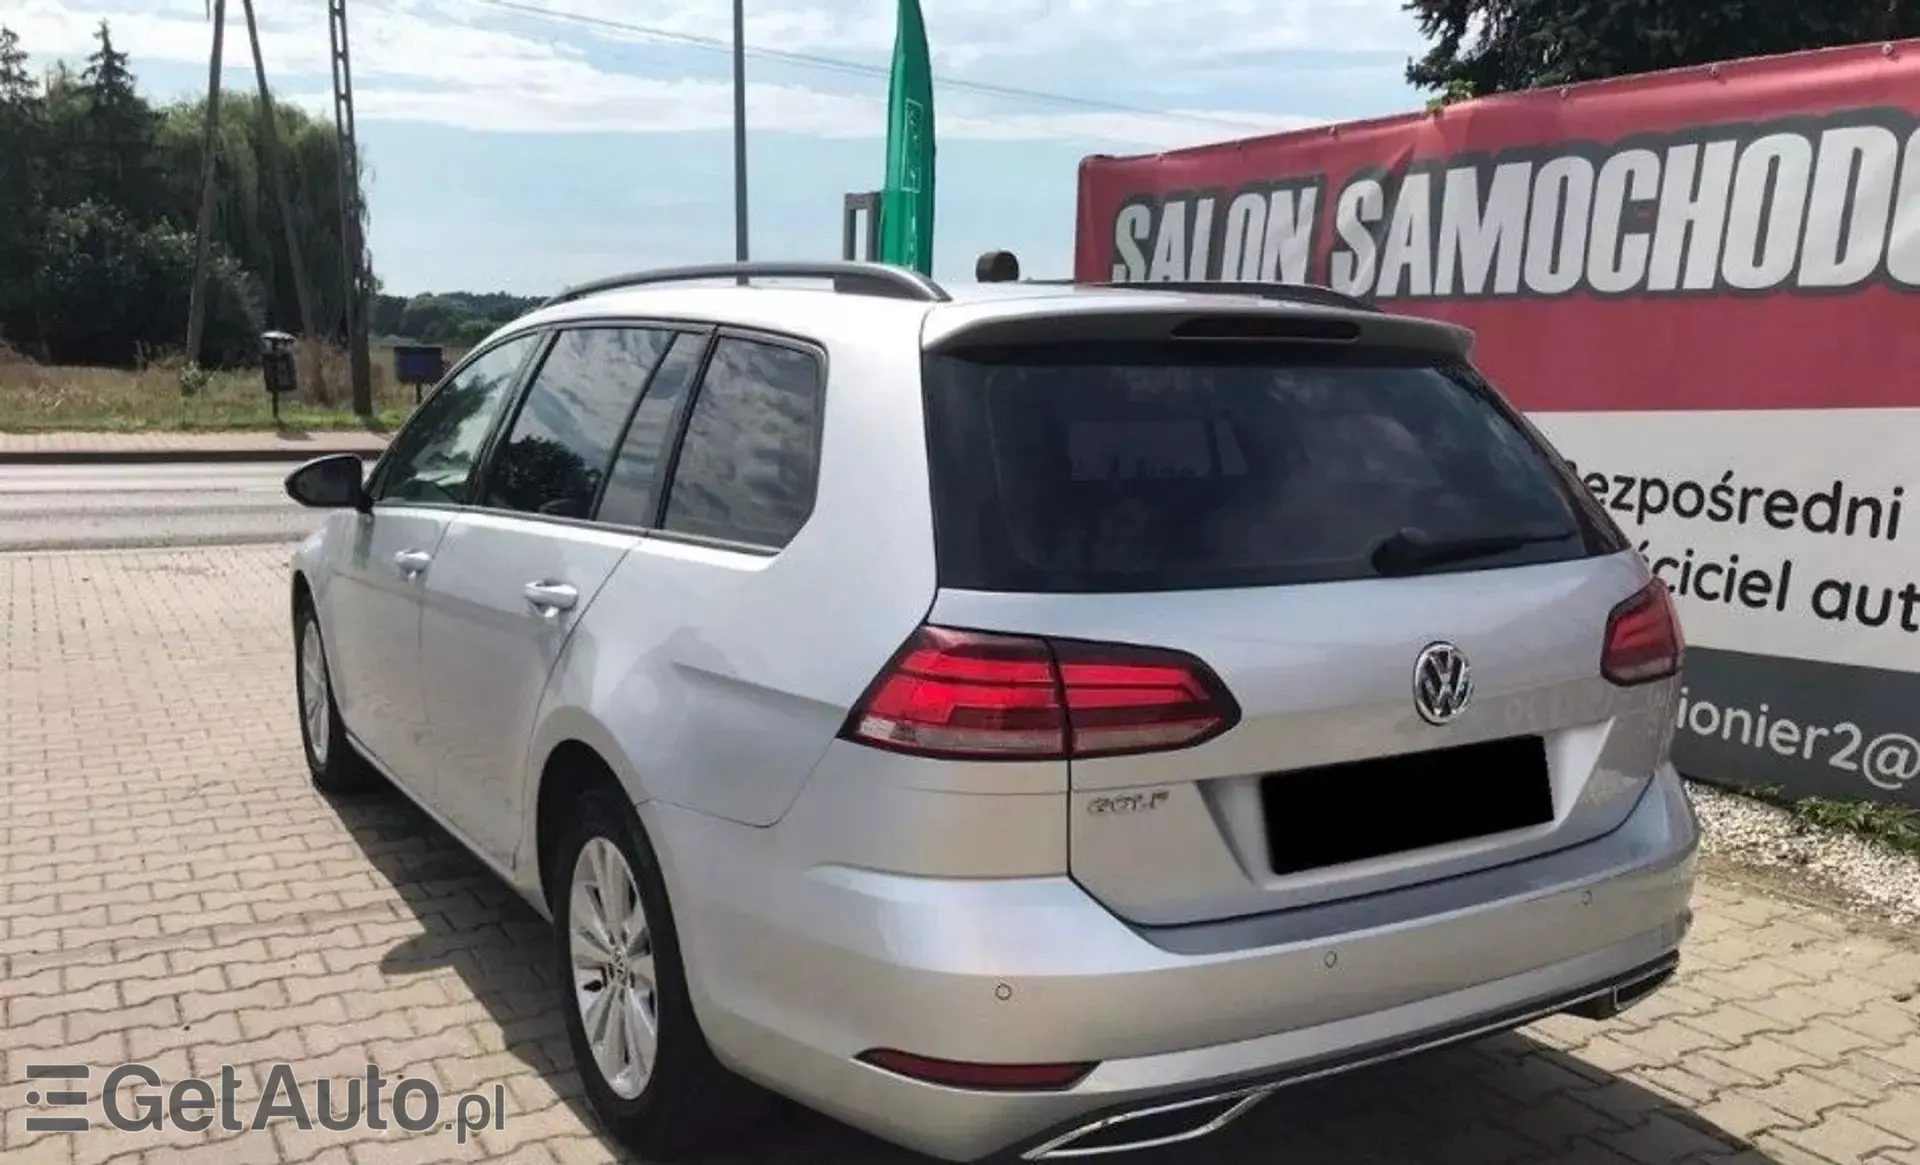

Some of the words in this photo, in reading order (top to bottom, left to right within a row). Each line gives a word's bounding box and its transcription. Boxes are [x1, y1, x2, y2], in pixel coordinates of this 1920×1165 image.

[1112, 186, 1319, 284] SALON
[1565, 460, 1905, 541] ezpośredni
[1639, 540, 1792, 612] ciciel
